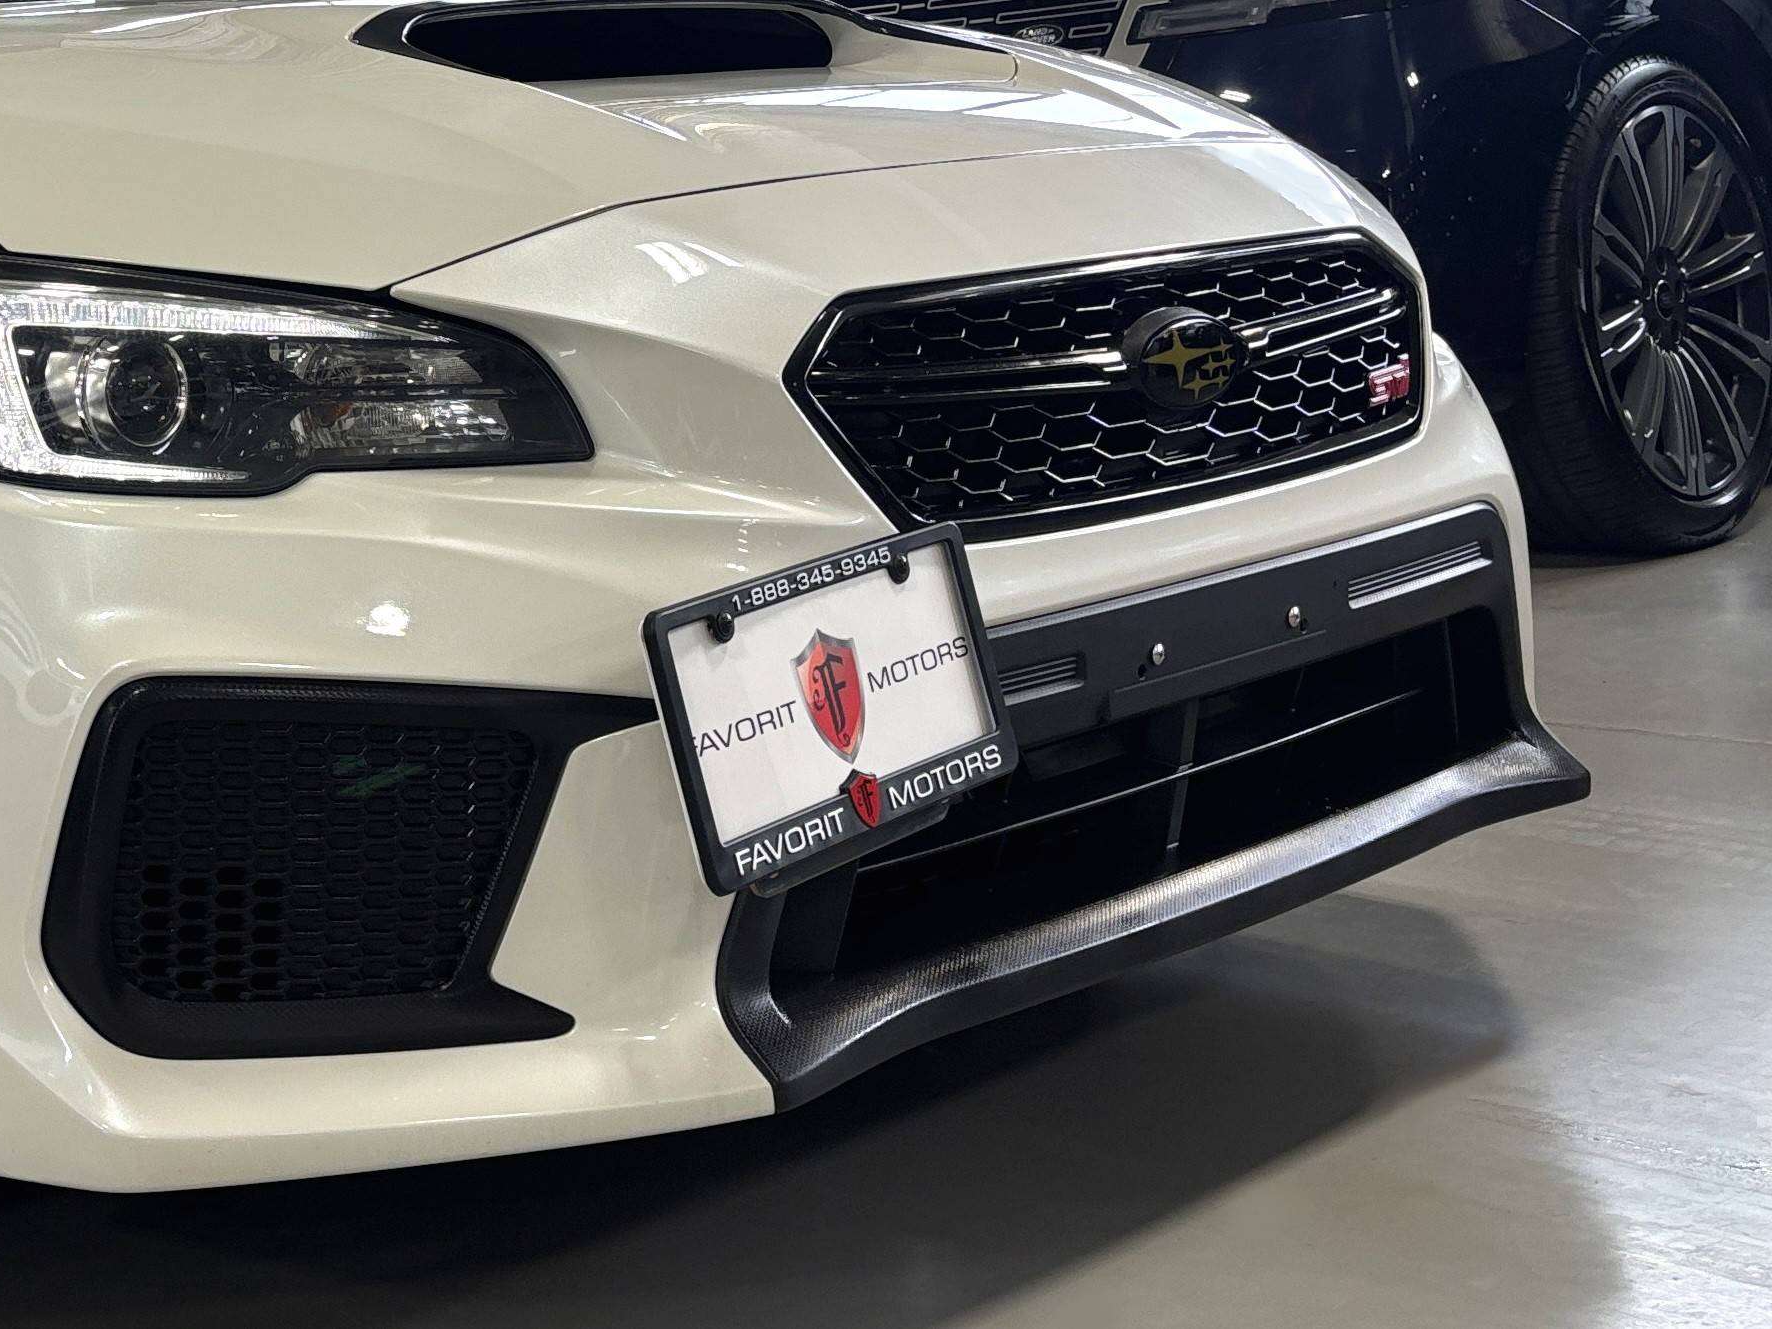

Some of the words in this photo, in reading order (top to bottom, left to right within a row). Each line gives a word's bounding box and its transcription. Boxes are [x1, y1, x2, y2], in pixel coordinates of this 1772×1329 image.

[731, 546, 892, 612] 1-888-345-9345
[867, 636, 968, 693] MOTORS
[735, 807, 845, 876] FAVORIT
[888, 743, 1002, 809] MOTORS
